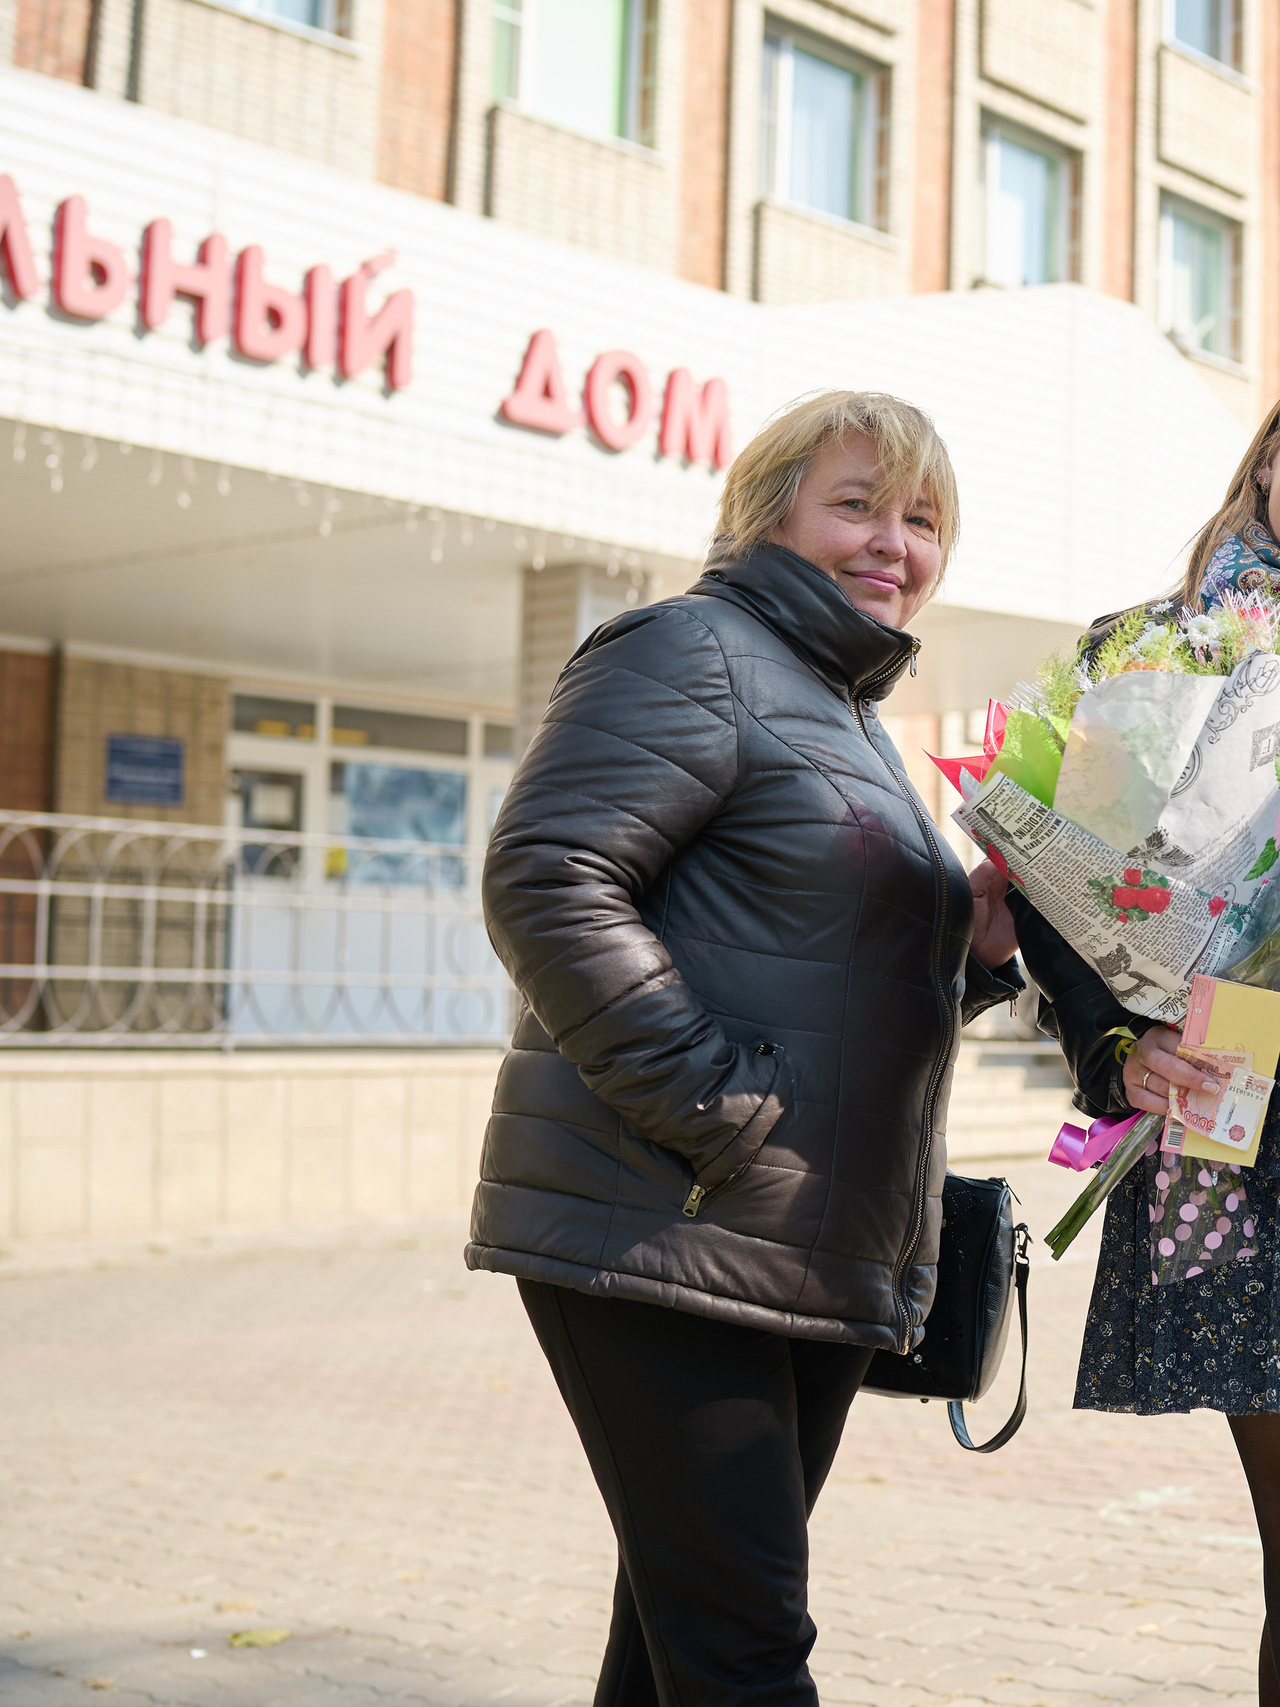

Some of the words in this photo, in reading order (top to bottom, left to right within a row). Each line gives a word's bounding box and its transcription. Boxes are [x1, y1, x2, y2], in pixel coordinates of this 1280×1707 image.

[500, 328, 733, 470] ДОМ
[1013, 803, 1049, 840] NEDICTINS
[1183, 1110, 1217, 1133] 5000
